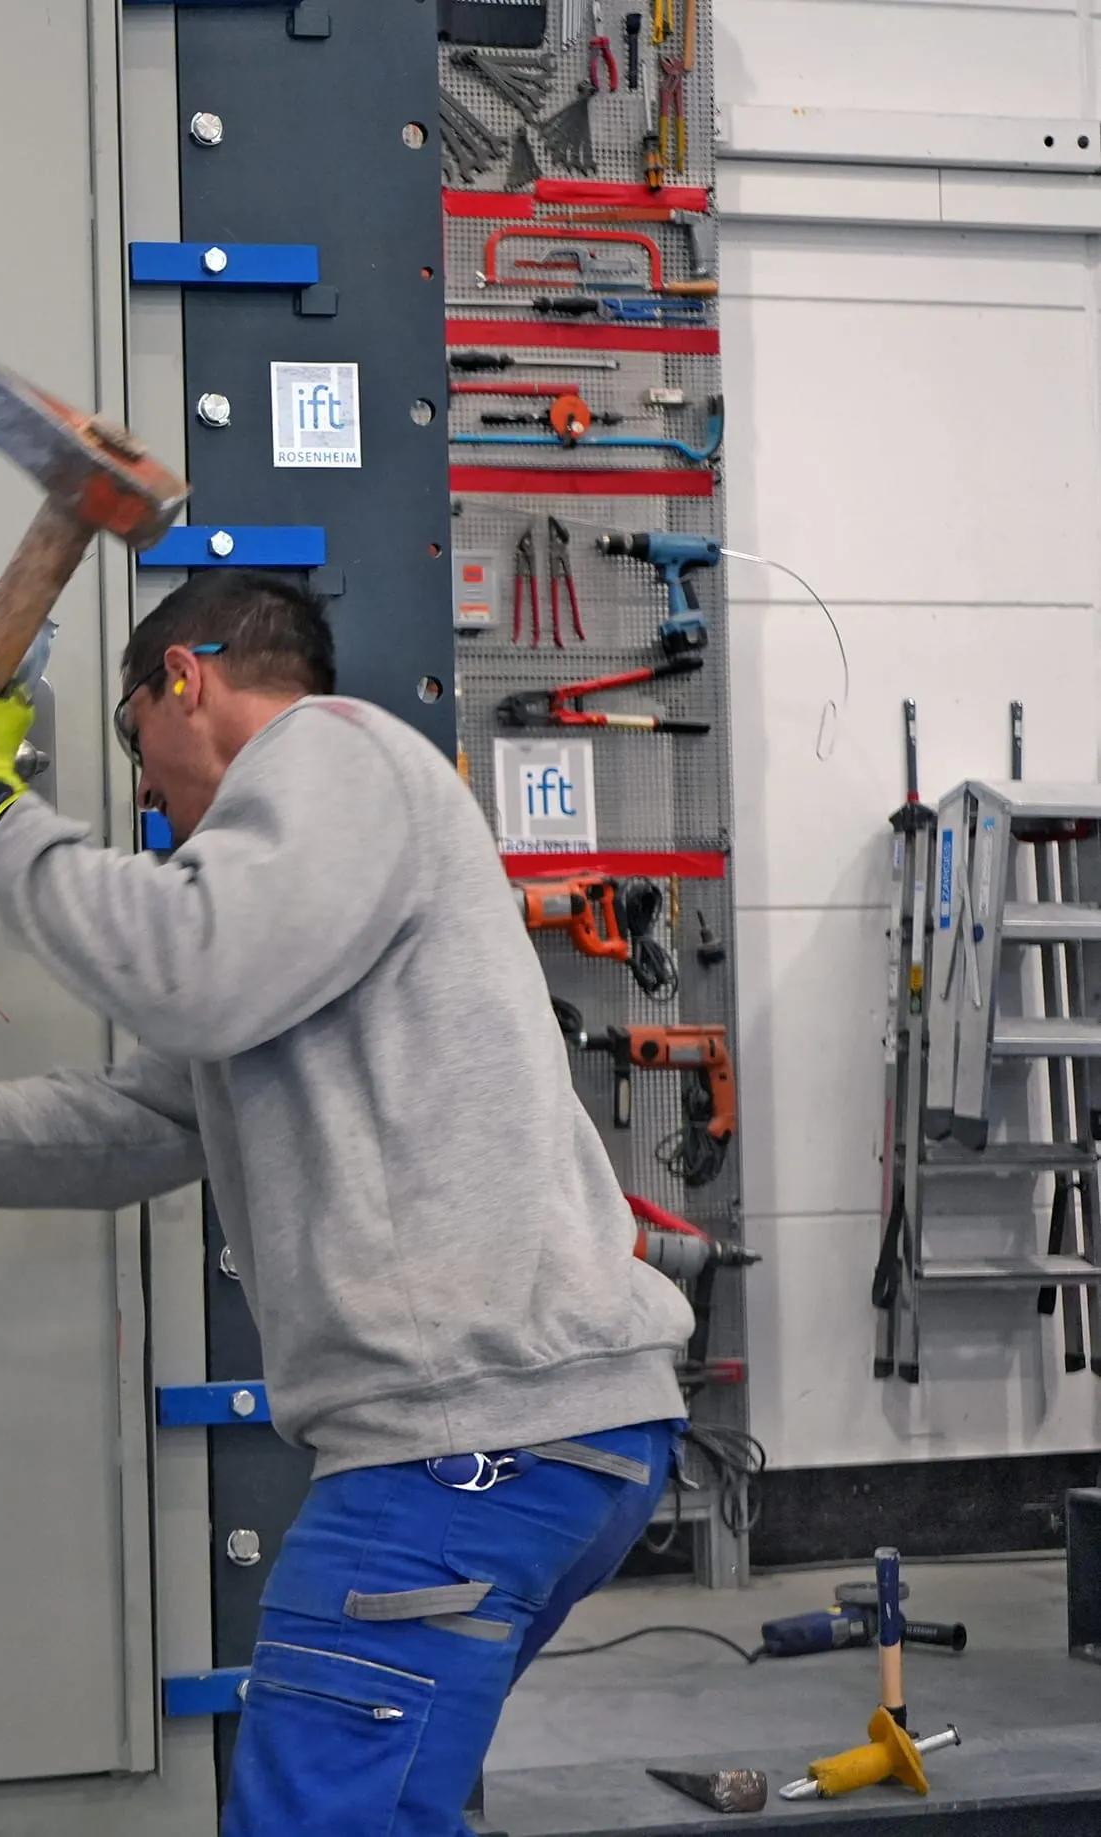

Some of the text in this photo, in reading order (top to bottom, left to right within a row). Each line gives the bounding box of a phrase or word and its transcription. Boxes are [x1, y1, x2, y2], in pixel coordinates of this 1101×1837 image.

[297, 384, 346, 430] ift
[278, 451, 357, 463] ROSENHEIM
[526, 767, 577, 816] ift
